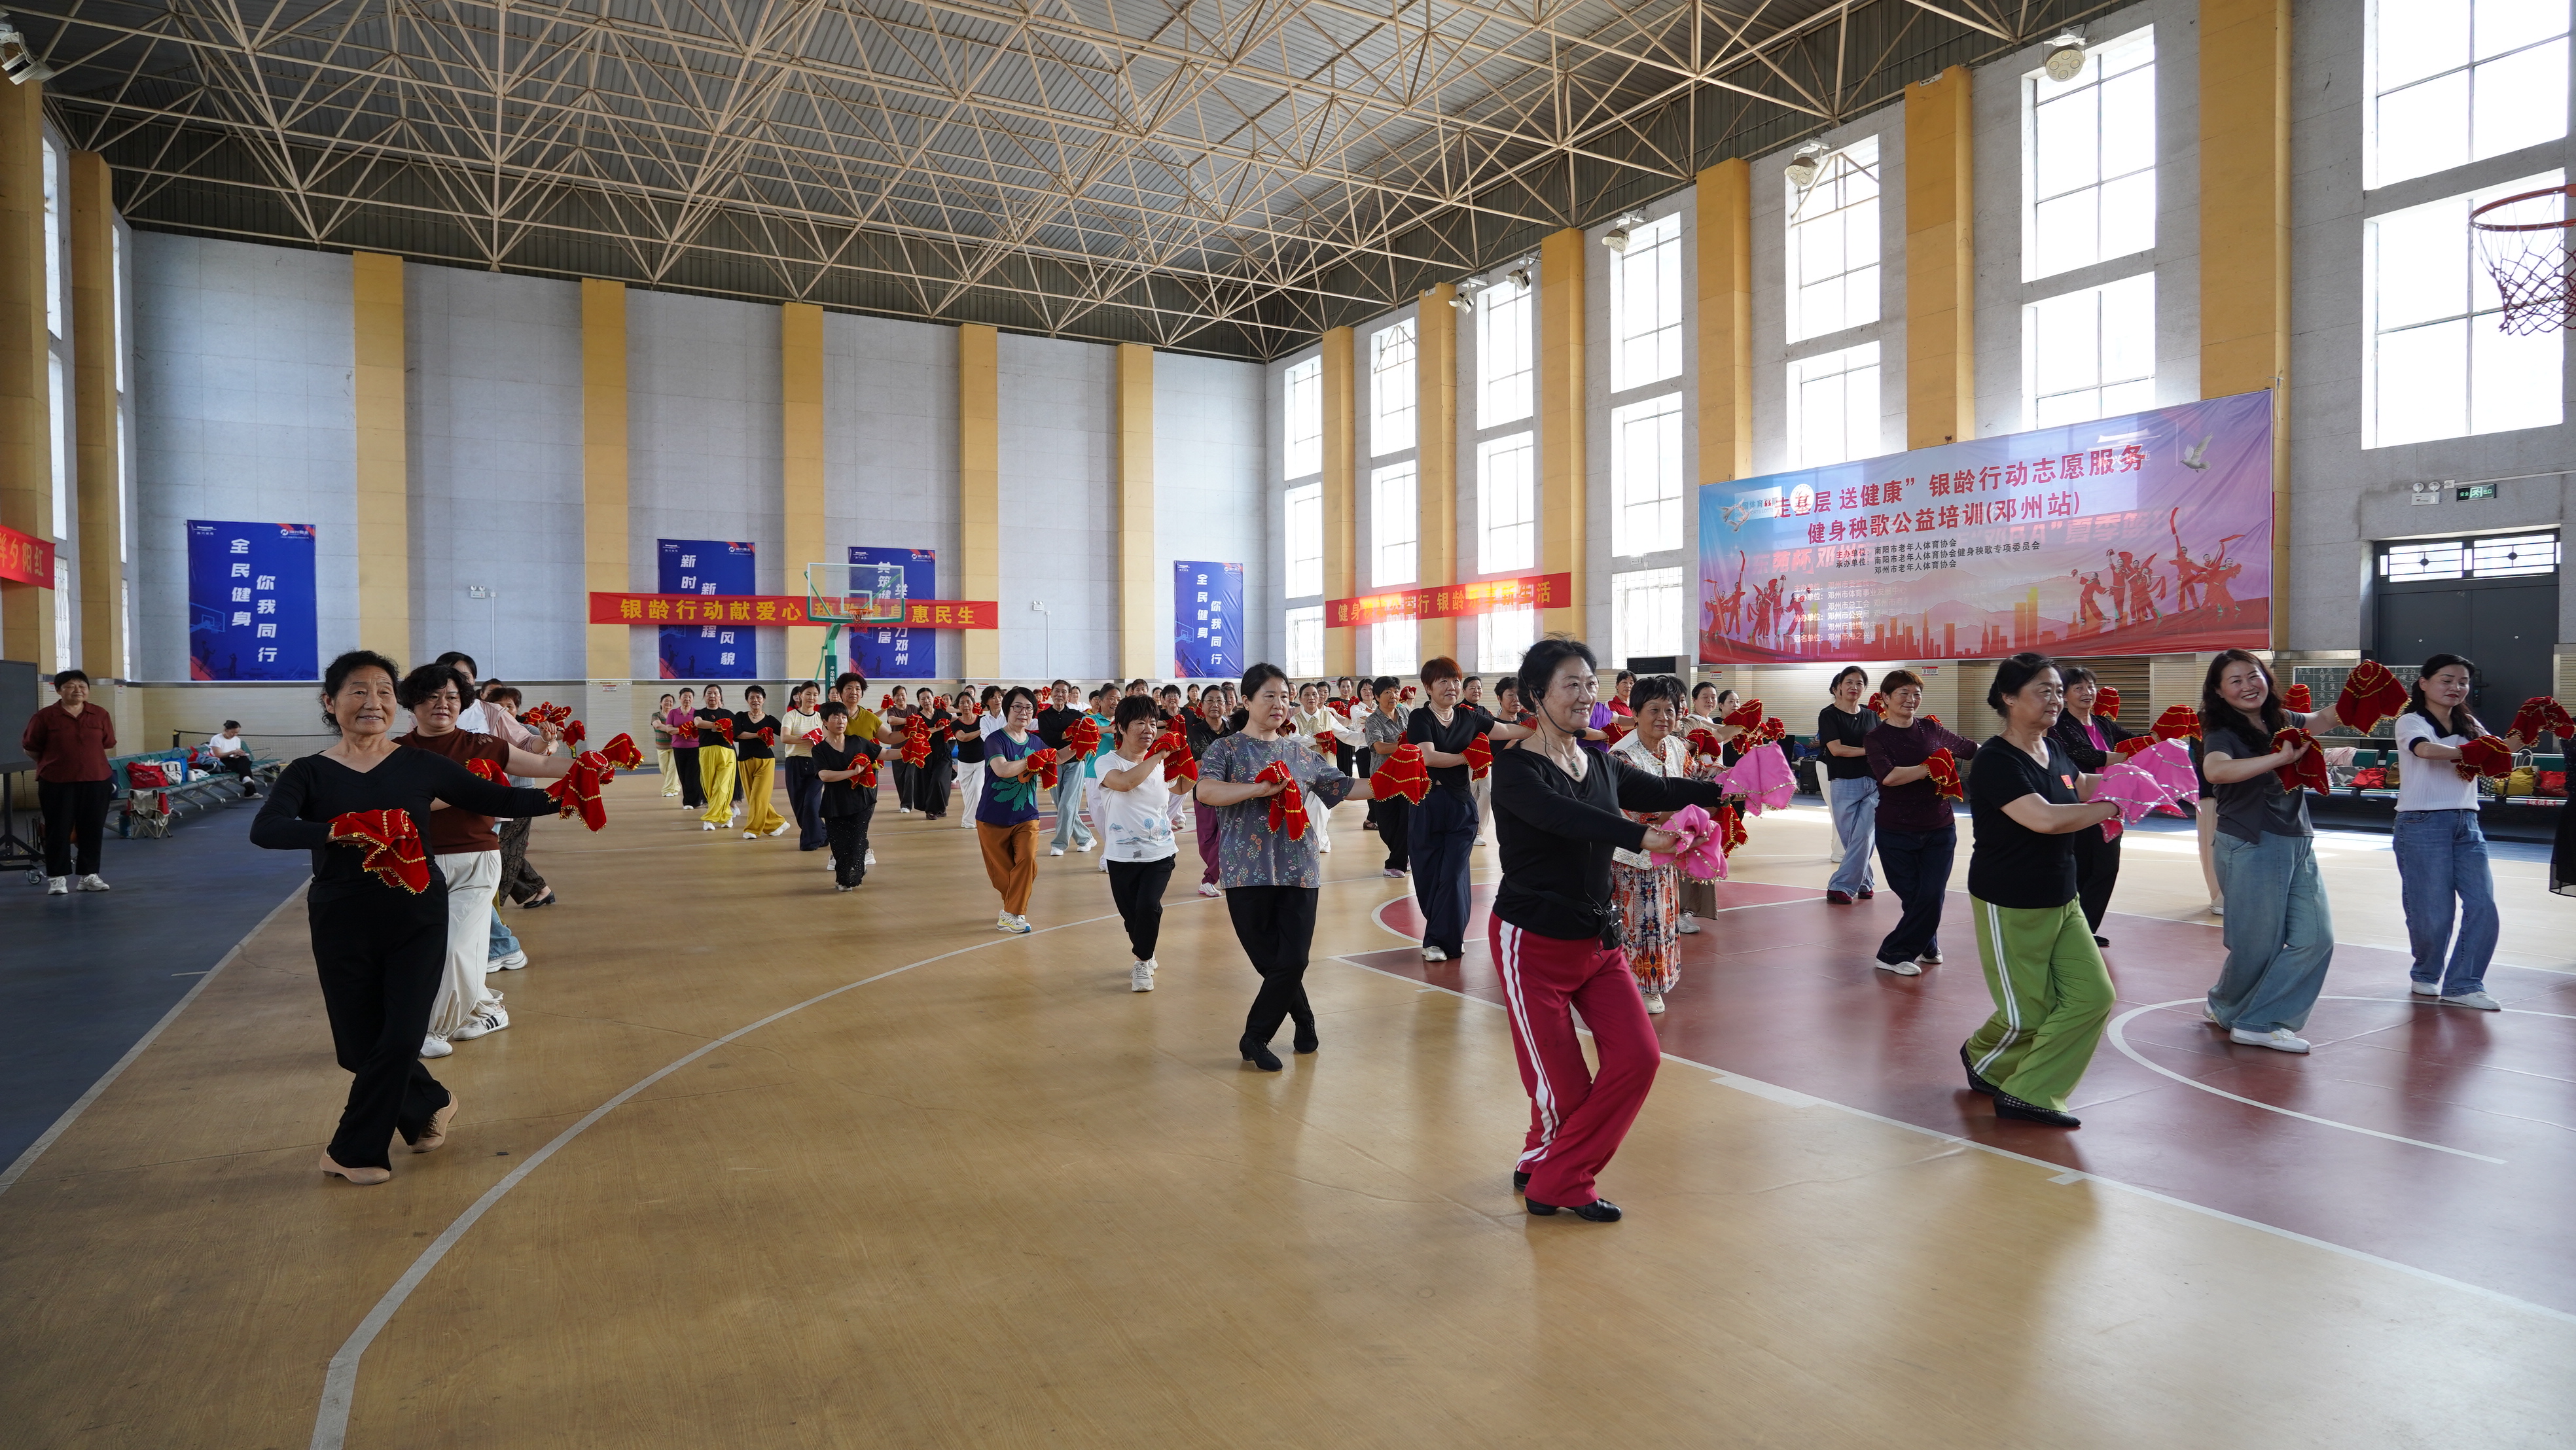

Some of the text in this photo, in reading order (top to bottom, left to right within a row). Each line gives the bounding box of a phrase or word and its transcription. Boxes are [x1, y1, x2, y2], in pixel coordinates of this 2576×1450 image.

[1839, 477, 1915, 510] 送健康”
[1929, 444, 2147, 498] 银龄行动志愿服务
[1807, 491, 2080, 544] 健身秧歌公益培训(邓州站)
[1874, 539, 1957, 554] 南阳市老年人体育协会
[1874, 540, 2041, 565] 南阳市老年人体育协会健身秧歌专项委员会
[1874, 559, 1957, 575] 邓州市老年人体育协会
[230, 539, 251, 626] 全民健身
[1196, 573, 1208, 639] 全民健身
[1338, 581, 1551, 622] 健身秧歌公益行 银龄乐享新生活
[257, 575, 277, 662] 你我同行
[620, 598, 802, 622] 银龄行动献爱心
[701, 583, 717, 638] 新程
[1211, 600, 1222, 665] 你我同行
[1827, 609, 1870, 620] 邓州市公安局
